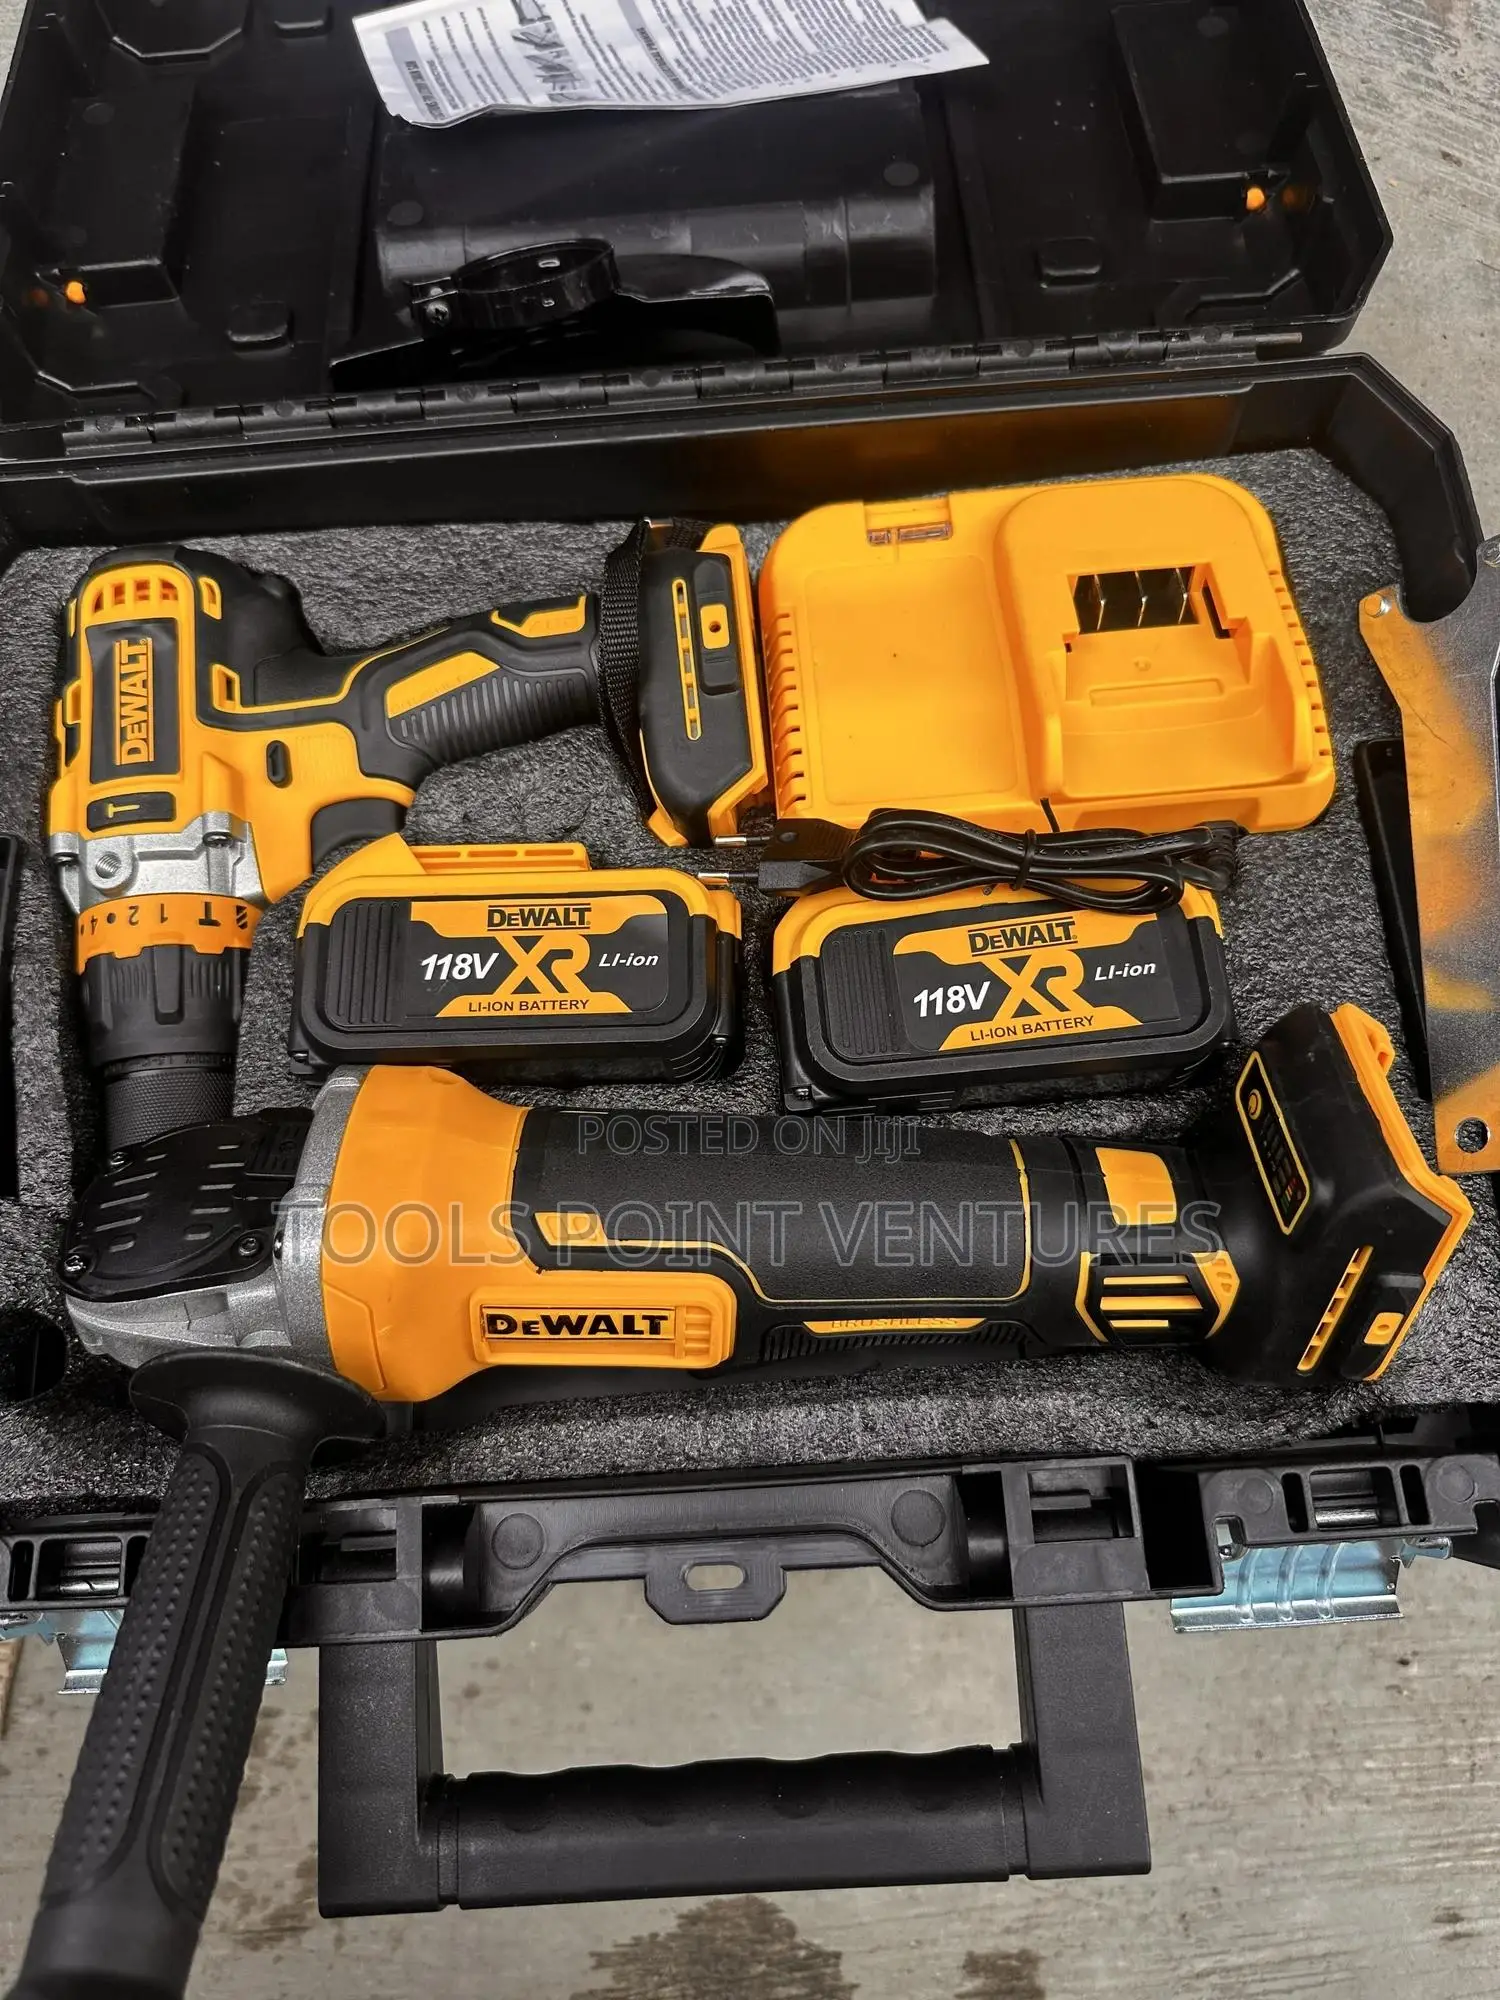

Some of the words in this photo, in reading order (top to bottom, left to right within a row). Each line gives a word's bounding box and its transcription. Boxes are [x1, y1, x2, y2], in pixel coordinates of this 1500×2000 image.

[118, 637, 151, 766] DEWALT
[128, 905, 140, 926] 2
[487, 907, 592, 928] DEWALT
[969, 921, 1077, 954] DEWALT
[420, 952, 500, 981] 118V
[494, 934, 592, 995] XR
[598, 953, 660, 968] LI-ion
[913, 981, 991, 1018] 118V
[983, 950, 1096, 1020] XR
[1094, 963, 1157, 982] LI-ion
[468, 1001, 514, 1013] LI-ION
[518, 999, 590, 1012] BATTERY
[970, 1027, 1018, 1042] LI-ION
[1022, 1015, 1095, 1035] BATTERY
[485, 1313, 669, 1337] DEWALT
